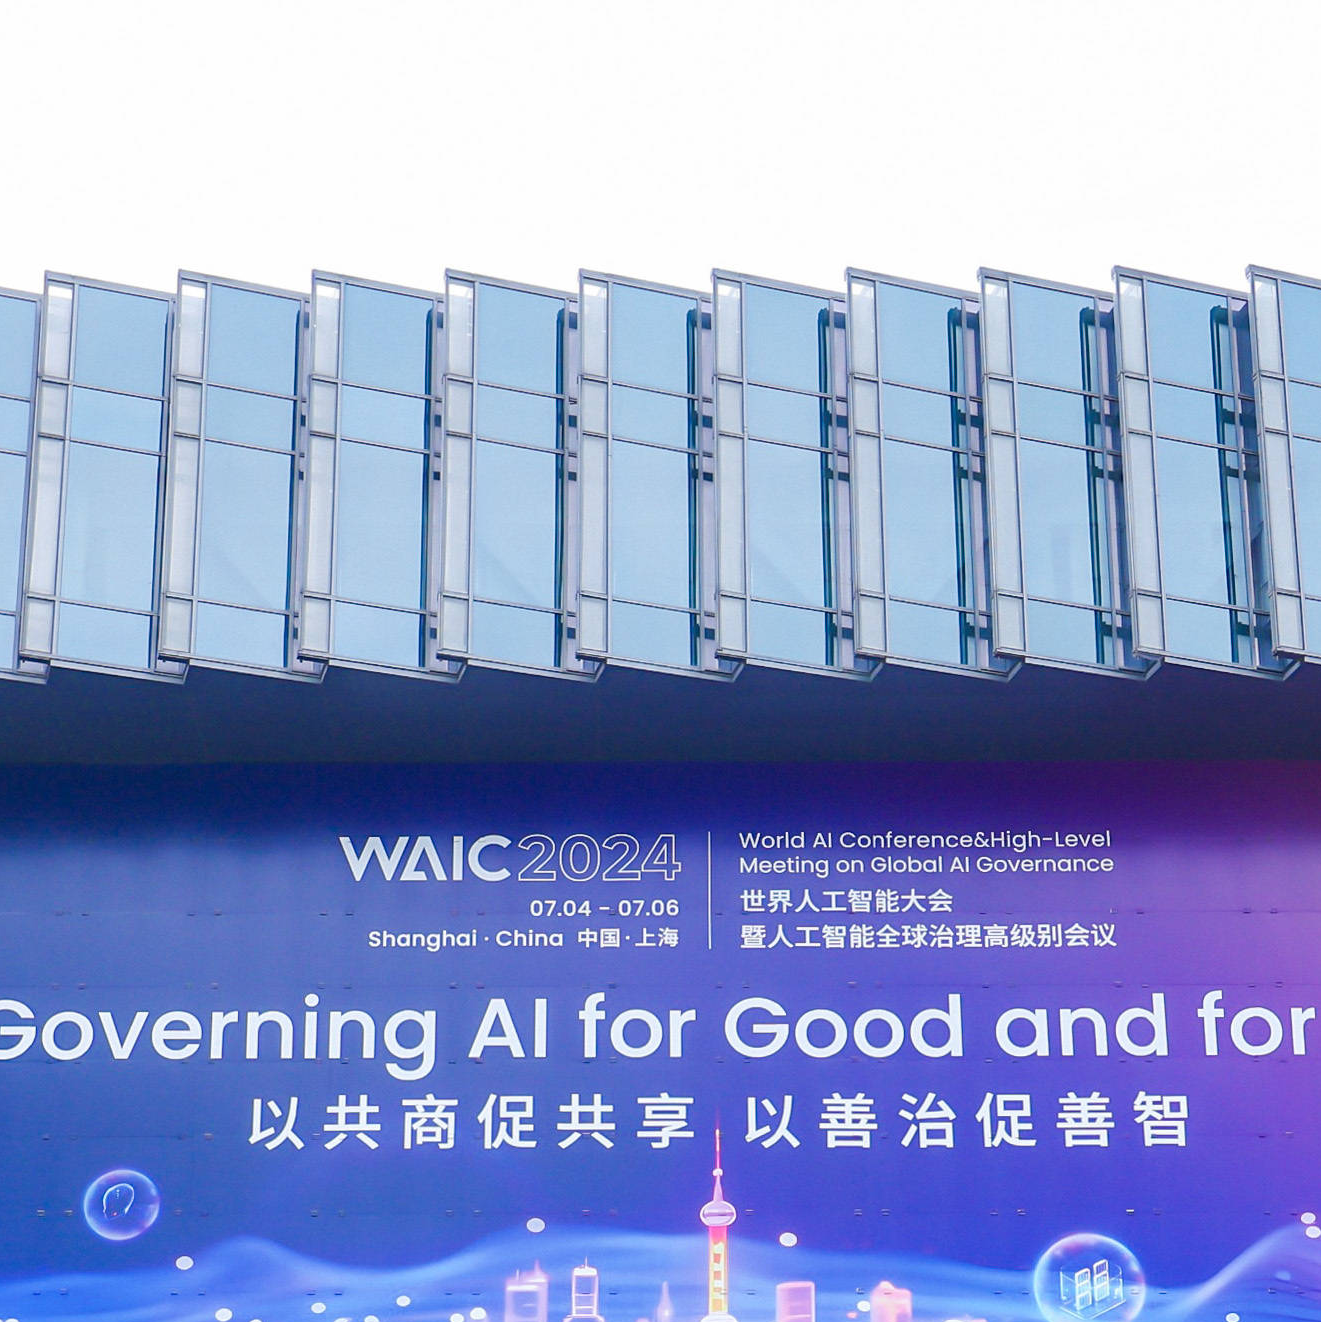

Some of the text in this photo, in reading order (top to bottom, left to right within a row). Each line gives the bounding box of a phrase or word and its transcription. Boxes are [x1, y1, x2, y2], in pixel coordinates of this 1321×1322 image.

[739, 830, 1112, 853] World AI Conference&High-Level
[739, 855, 1114, 879] Meeting on Global AI Governance
[530, 900, 592, 917] 07.04
[618, 900, 679, 917] 07.06
[740, 888, 954, 914] 世界人工智能大会
[368, 929, 477, 953] Shanghai
[495, 929, 564, 948] China
[740, 923, 1118, 950] 暨人工智能全球治理高级别会议
[468, 998, 547, 1058] AI
[579, 992, 696, 1059] for
[724, 993, 962, 1058] Good
[995, 993, 1168, 1058] and
[1197, 990, 1316, 1057] for
[248, 1091, 1189, 1151] 以共商促共享 以善治促善智
